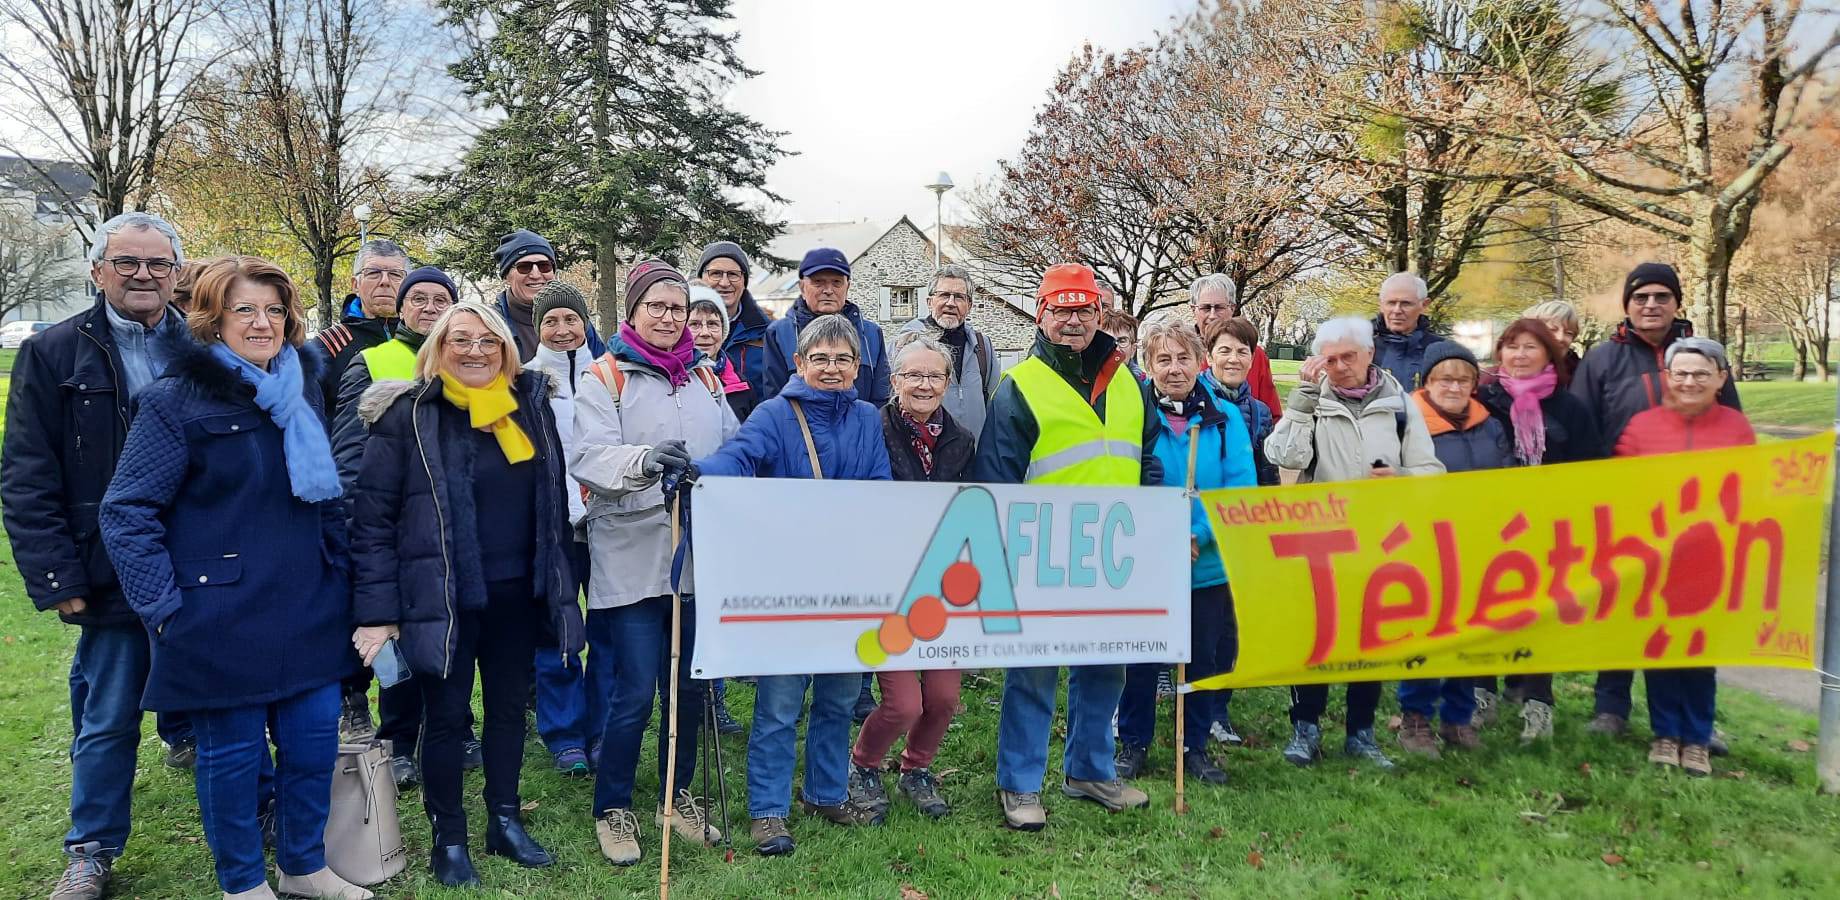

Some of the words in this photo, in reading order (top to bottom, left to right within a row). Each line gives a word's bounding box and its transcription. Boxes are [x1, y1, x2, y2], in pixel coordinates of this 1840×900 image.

[1215, 492, 1347, 525] telethon.fr
[889, 485, 1136, 635] AFLEC
[721, 594, 818, 610] ASSOCIATION
[823, 593, 893, 607] FAMILIALE
[918, 646, 970, 659] LOISIRS
[974, 645, 989, 657] ET
[993, 643, 1050, 657] CULTURE
